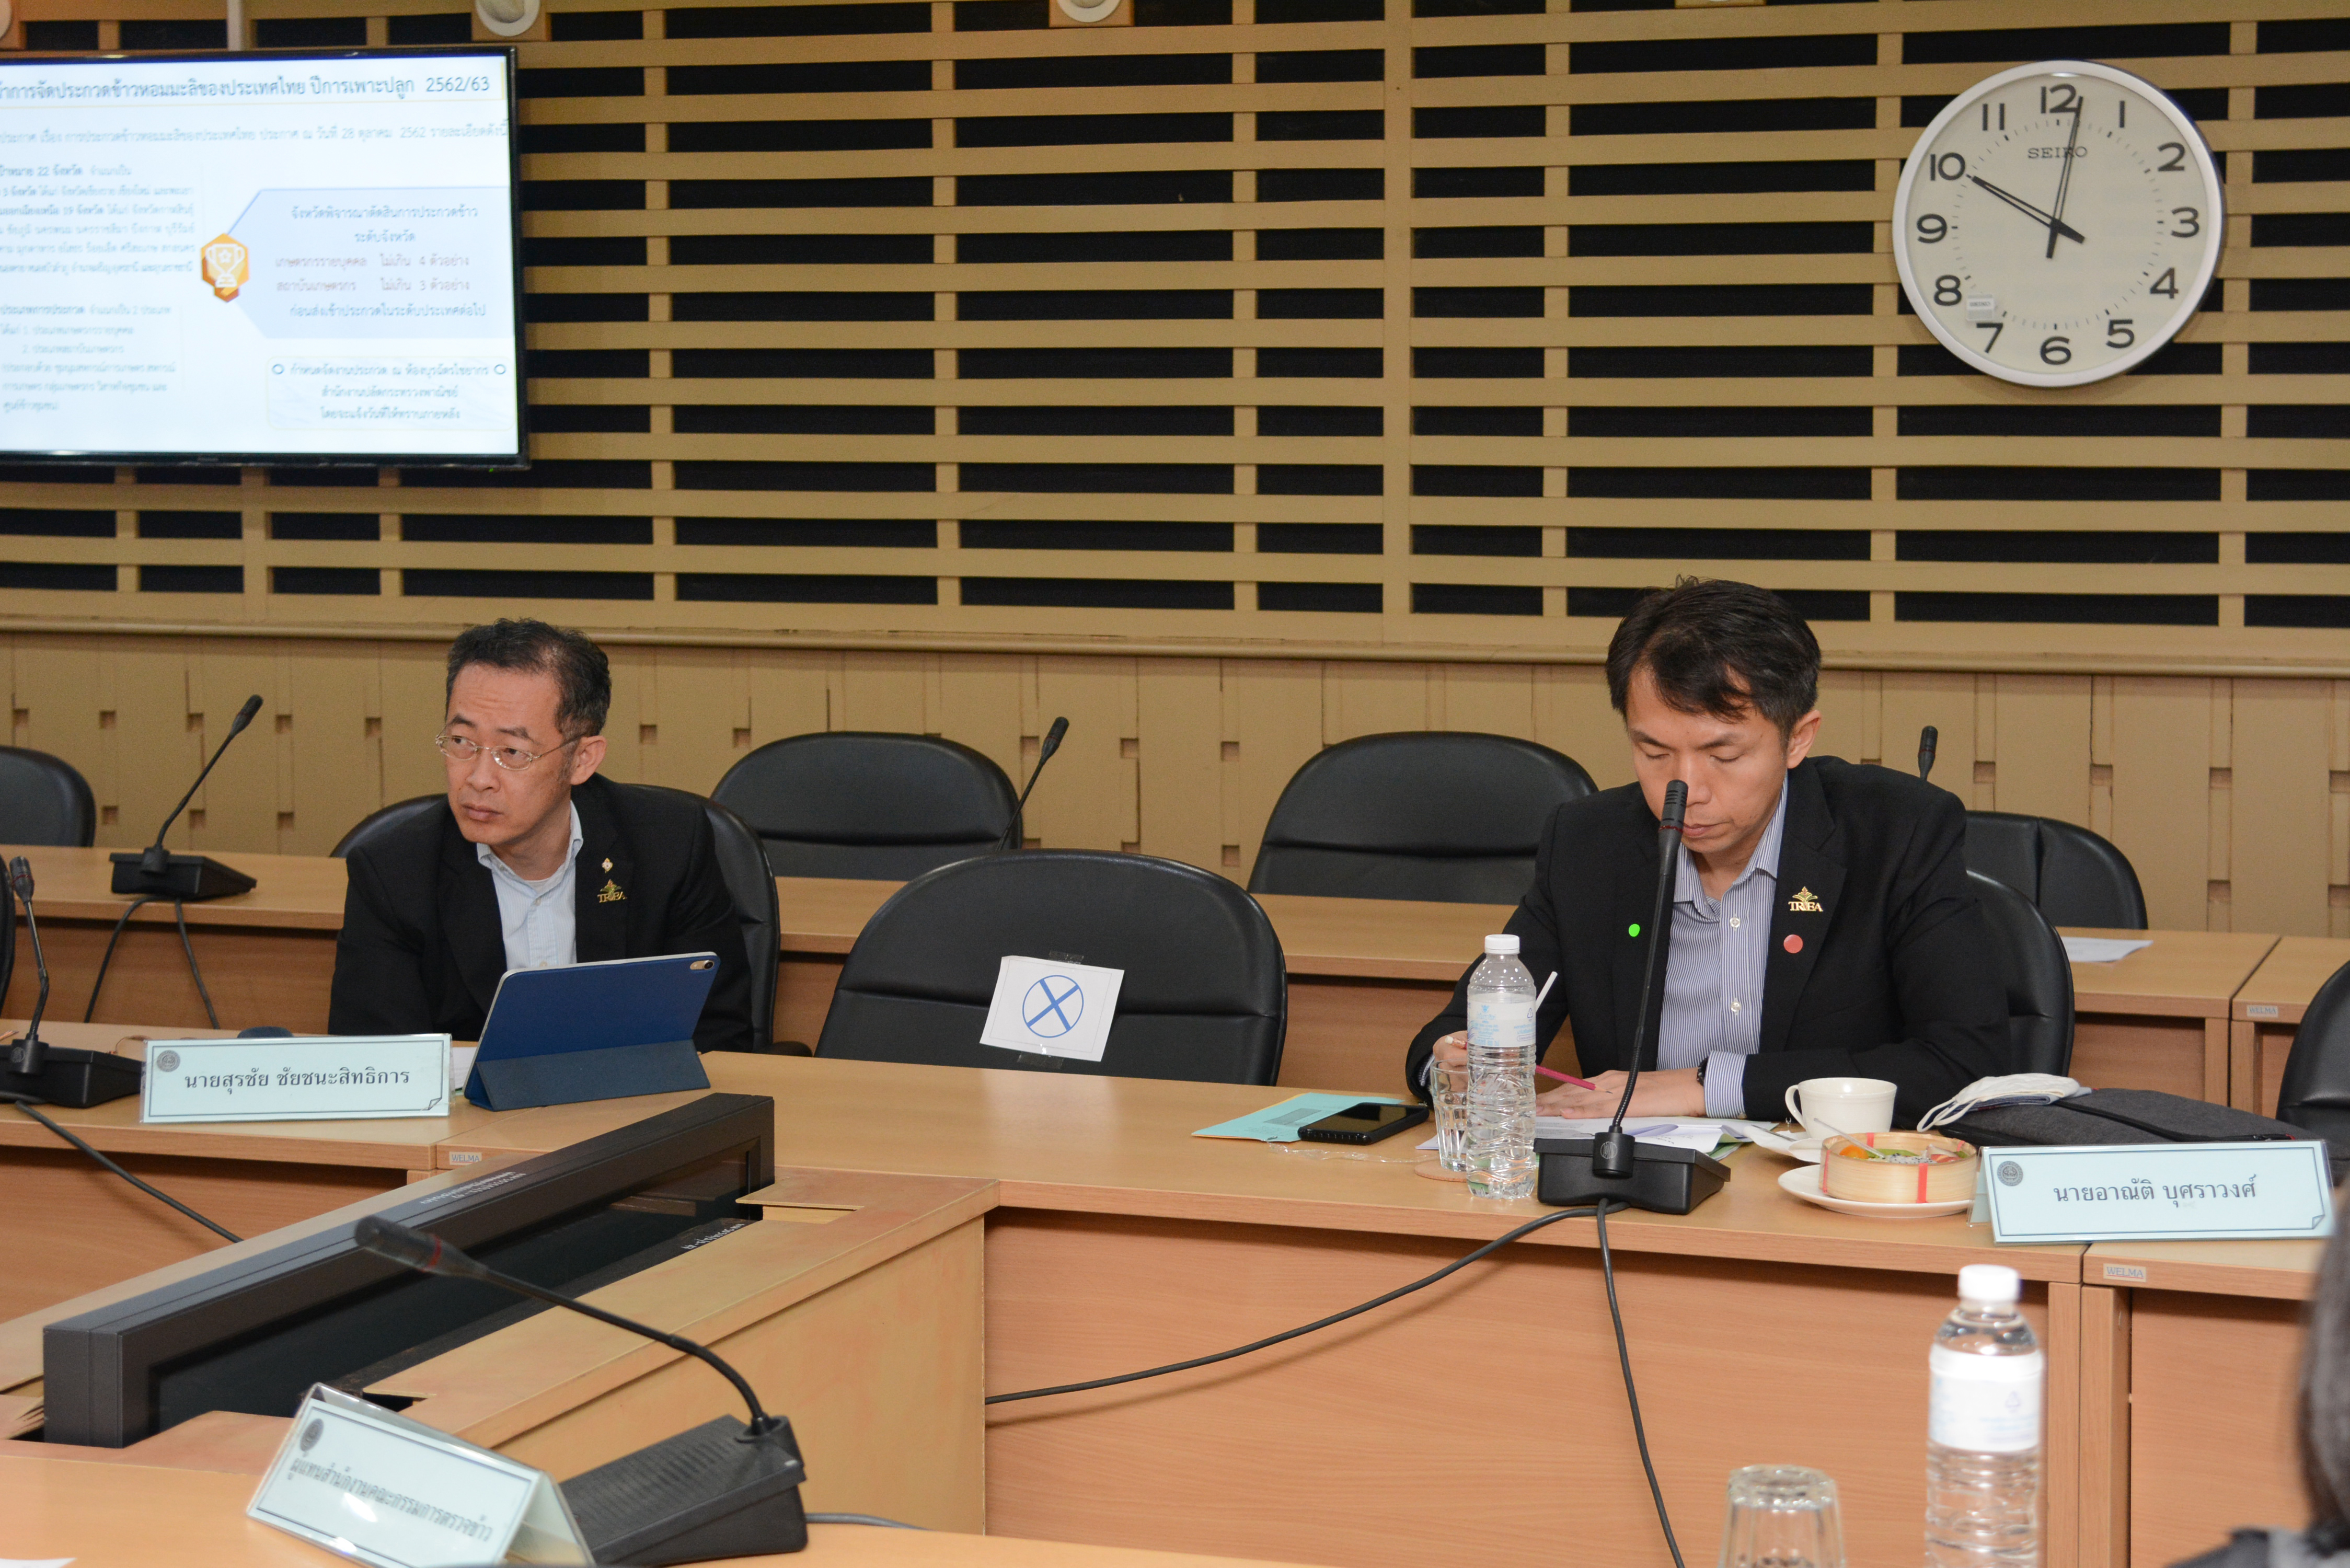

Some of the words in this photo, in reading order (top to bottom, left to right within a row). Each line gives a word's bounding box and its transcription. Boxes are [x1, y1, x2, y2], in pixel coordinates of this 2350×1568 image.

[309, 75, 415, 100] ปีการเพาะปลูก
[426, 76, 490, 93] 2562/63
[2041, 84, 2080, 114] 12
[1982, 103, 2005, 131] 11
[2118, 100, 2125, 128] 1
[400, 126, 426, 139] 2562
[1930, 152, 1966, 181] 10
[2158, 142, 2186, 172] 2
[1916, 214, 1948, 244] 9
[2171, 207, 2200, 238] 3
[1933, 275, 1962, 306] 8
[2149, 267, 2179, 299] 4
[1976, 322, 2003, 353] 7
[2106, 319, 2135, 349] 5
[2040, 337, 2071, 365] 6
[185, 1067, 269, 1094] นายสุรชัย
[277, 1066, 410, 1087] ชัยชนะสิทธิการ
[452, 1154, 480, 1162] WELMA
[2053, 1177, 2155, 1203] นายอาณัติ
[2162, 1173, 2258, 1208] บุศราวงศ์
[2106, 1266, 2144, 1278] WELMA
